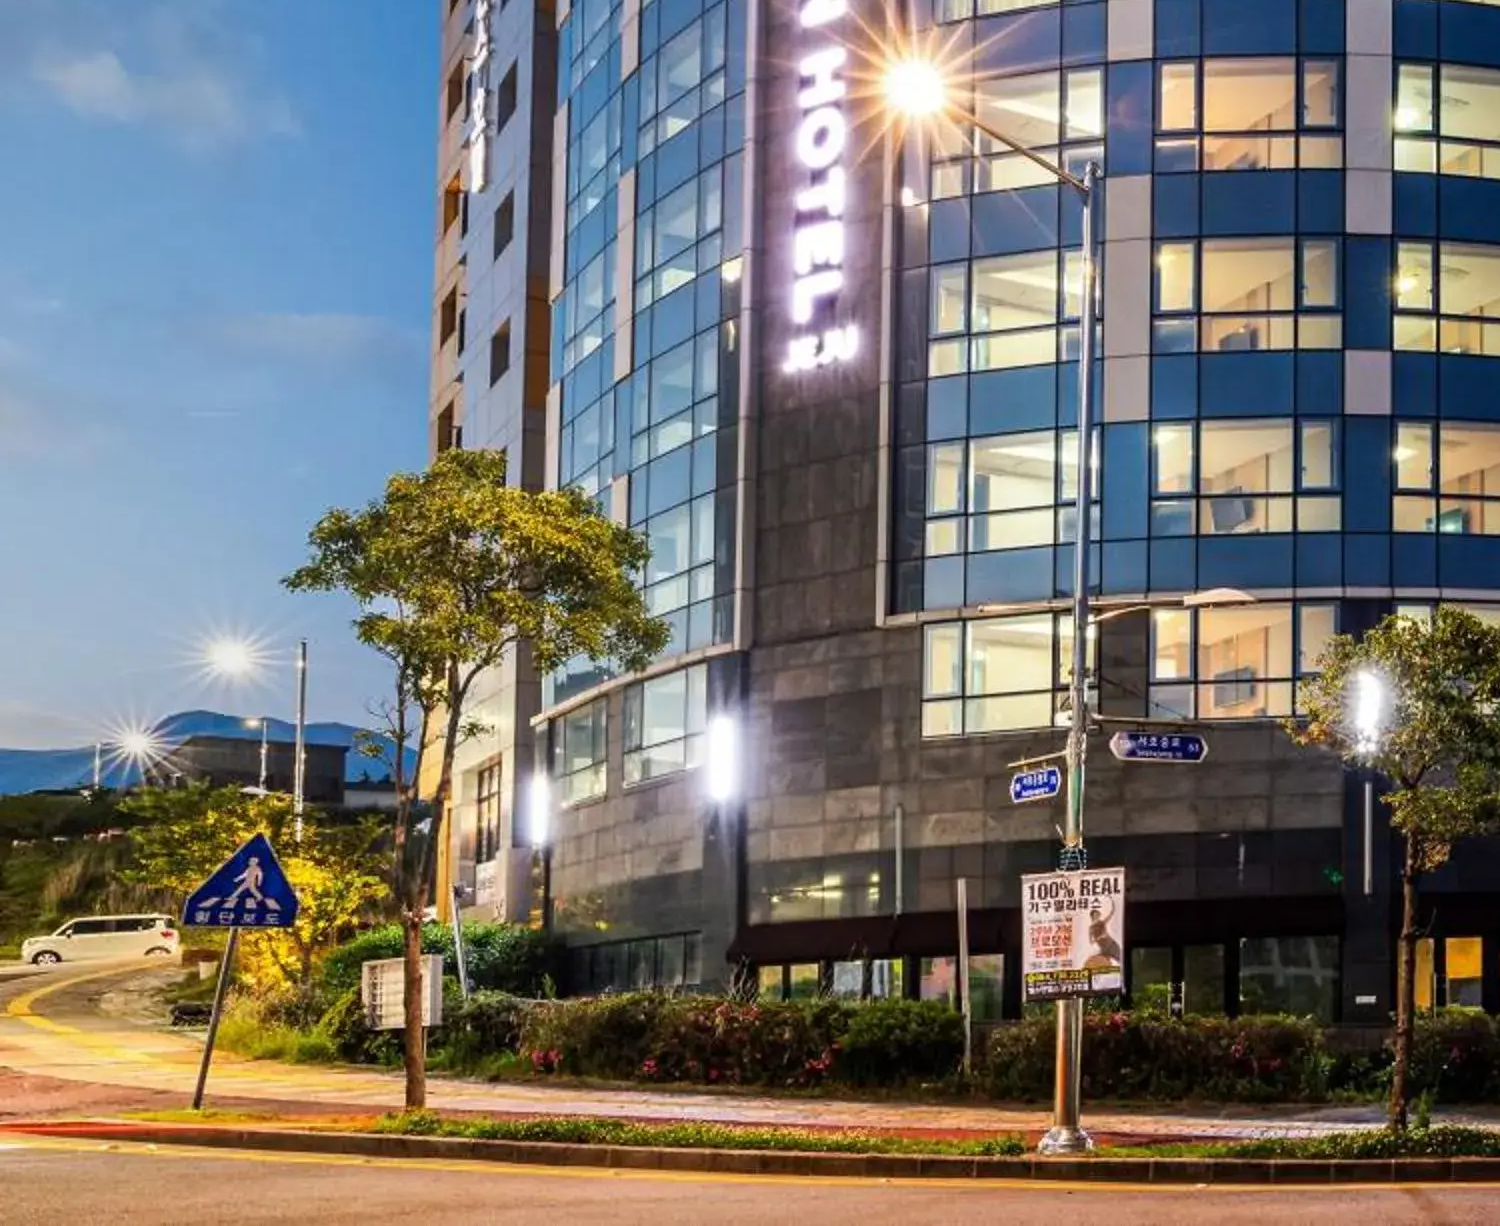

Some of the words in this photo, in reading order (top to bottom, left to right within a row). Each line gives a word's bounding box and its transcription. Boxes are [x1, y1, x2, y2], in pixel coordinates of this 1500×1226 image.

[793, 46, 847, 324] HOTEL
[1028, 880, 1075, 900] 100%
[1080, 877, 1120, 896] REAL
